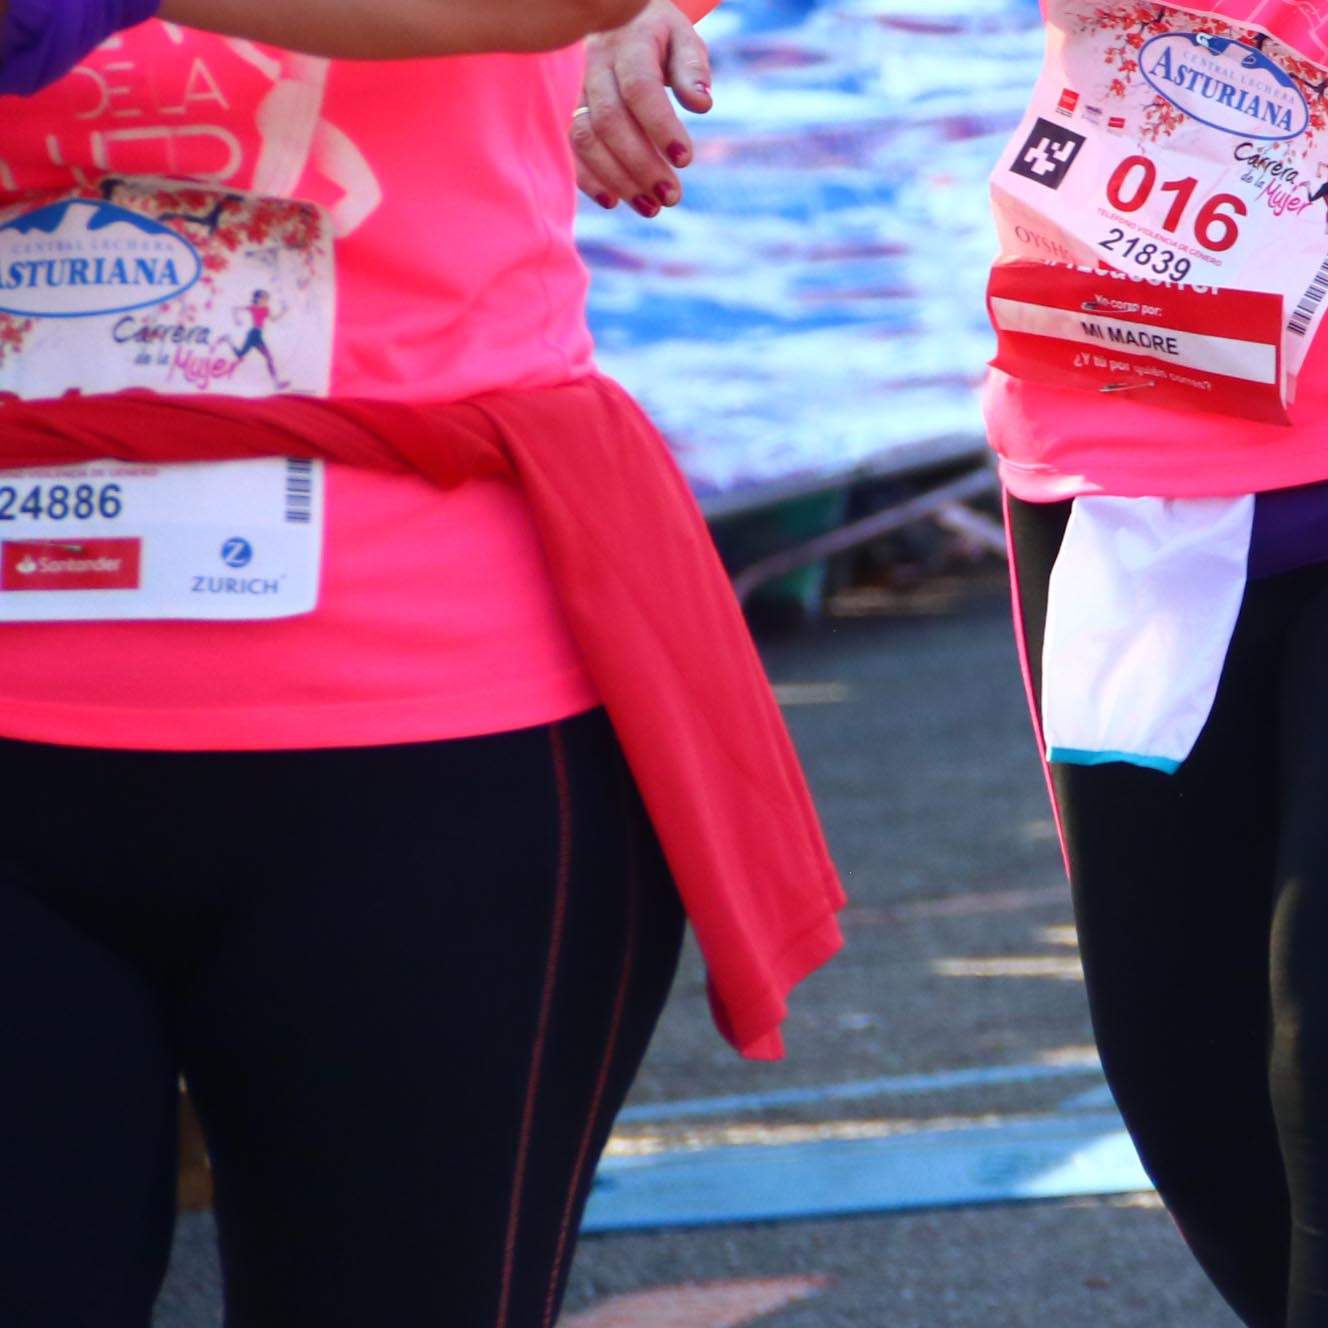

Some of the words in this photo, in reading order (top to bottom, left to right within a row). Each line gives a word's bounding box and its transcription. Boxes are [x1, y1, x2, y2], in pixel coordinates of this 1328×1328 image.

[1148, 45, 1295, 132] ASTURIANA
[1183, 49, 1236, 80] CENTRAL
[1240, 74, 1296, 105] LECHERA
[1234, 142, 1300, 185] Carrera
[1240, 169, 1254, 184] de
[1254, 173, 1266, 189] la
[1106, 154, 1248, 252] 016
[1255, 177, 1312, 217] Mujer
[12, 239, 83, 254] CENTRAL
[1099, 227, 1191, 282] 21839
[0, 257, 181, 290] STURIANA
[113, 315, 210, 344] Carrera
[1081, 321, 1105, 340] MI
[1107, 326, 1180, 356] MADRE
[166, 343, 244, 389] Mujer
[0, 483, 123, 521] 24886
[38, 556, 123, 573] Santander
[191, 575, 280, 594] ZURICH
